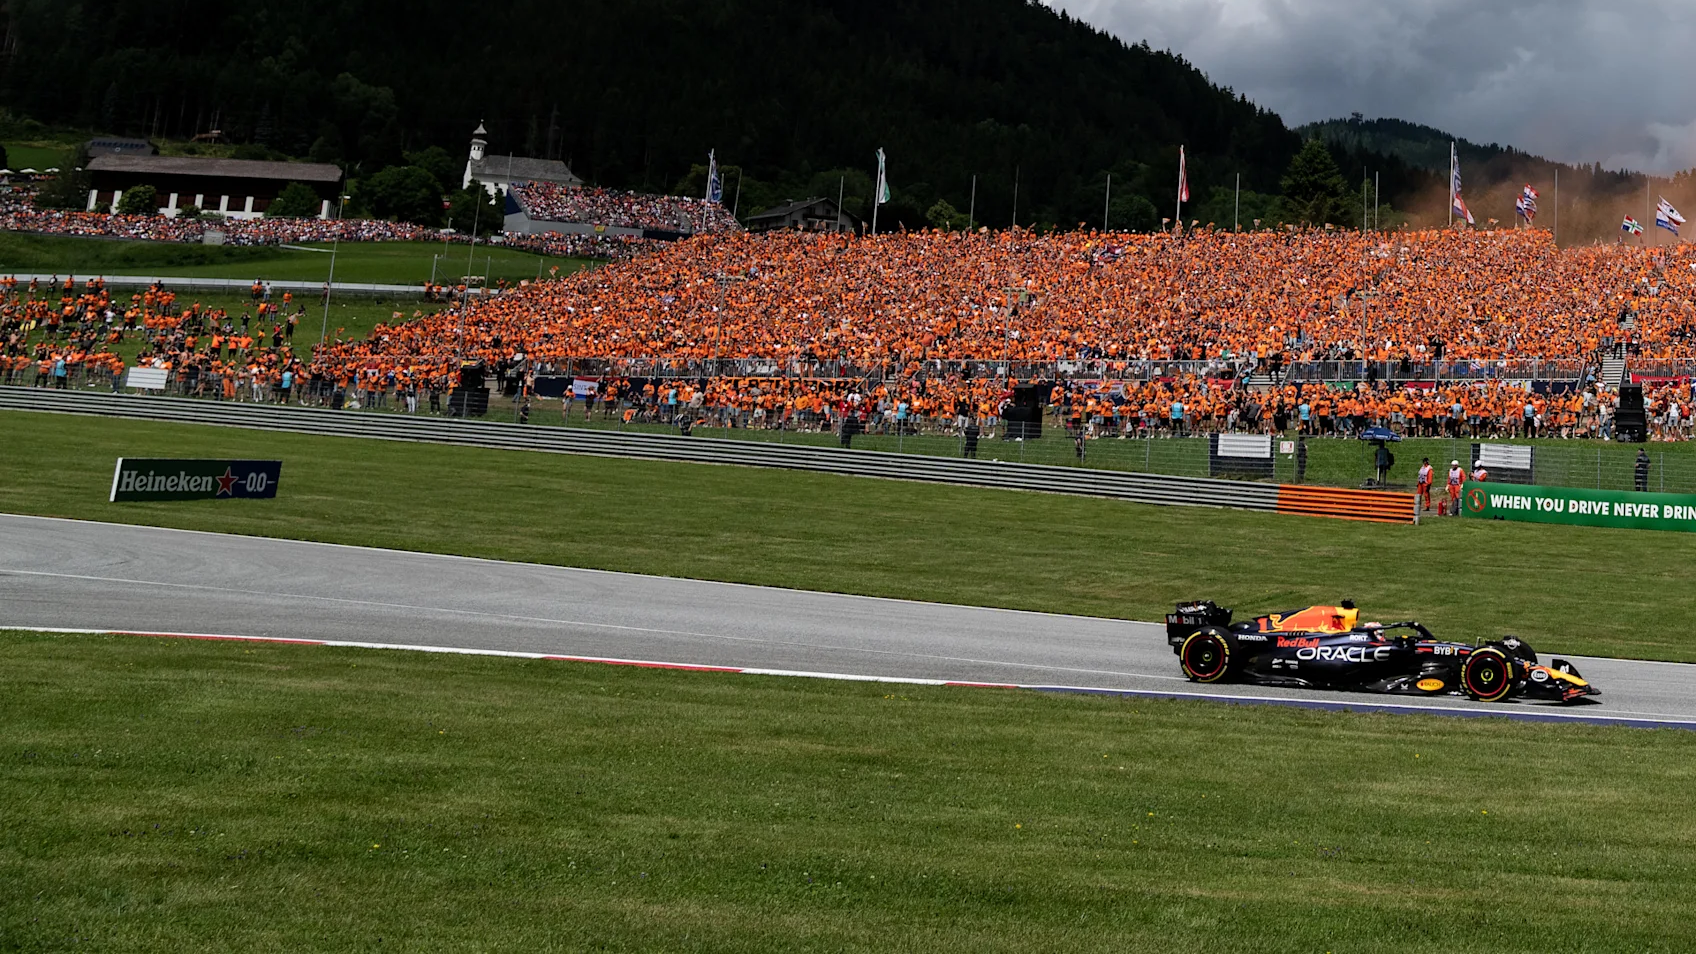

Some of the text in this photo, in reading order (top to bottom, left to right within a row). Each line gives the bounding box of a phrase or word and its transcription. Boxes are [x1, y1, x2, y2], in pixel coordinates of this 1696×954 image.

[119, 470, 213, 492] Heineken
[1491, 495, 1532, 510] WHEN
[1534, 497, 1565, 513] YOU
[1568, 499, 1610, 516] DRIVE
[1613, 502, 1659, 519] NEVER
[1167, 615, 1195, 625] Mobil
[1257, 617, 1268, 632] 1
[1349, 634, 1369, 642] ROKT
[1296, 646, 1391, 663] ORACLE
[1433, 646, 1460, 656] BYBIT
